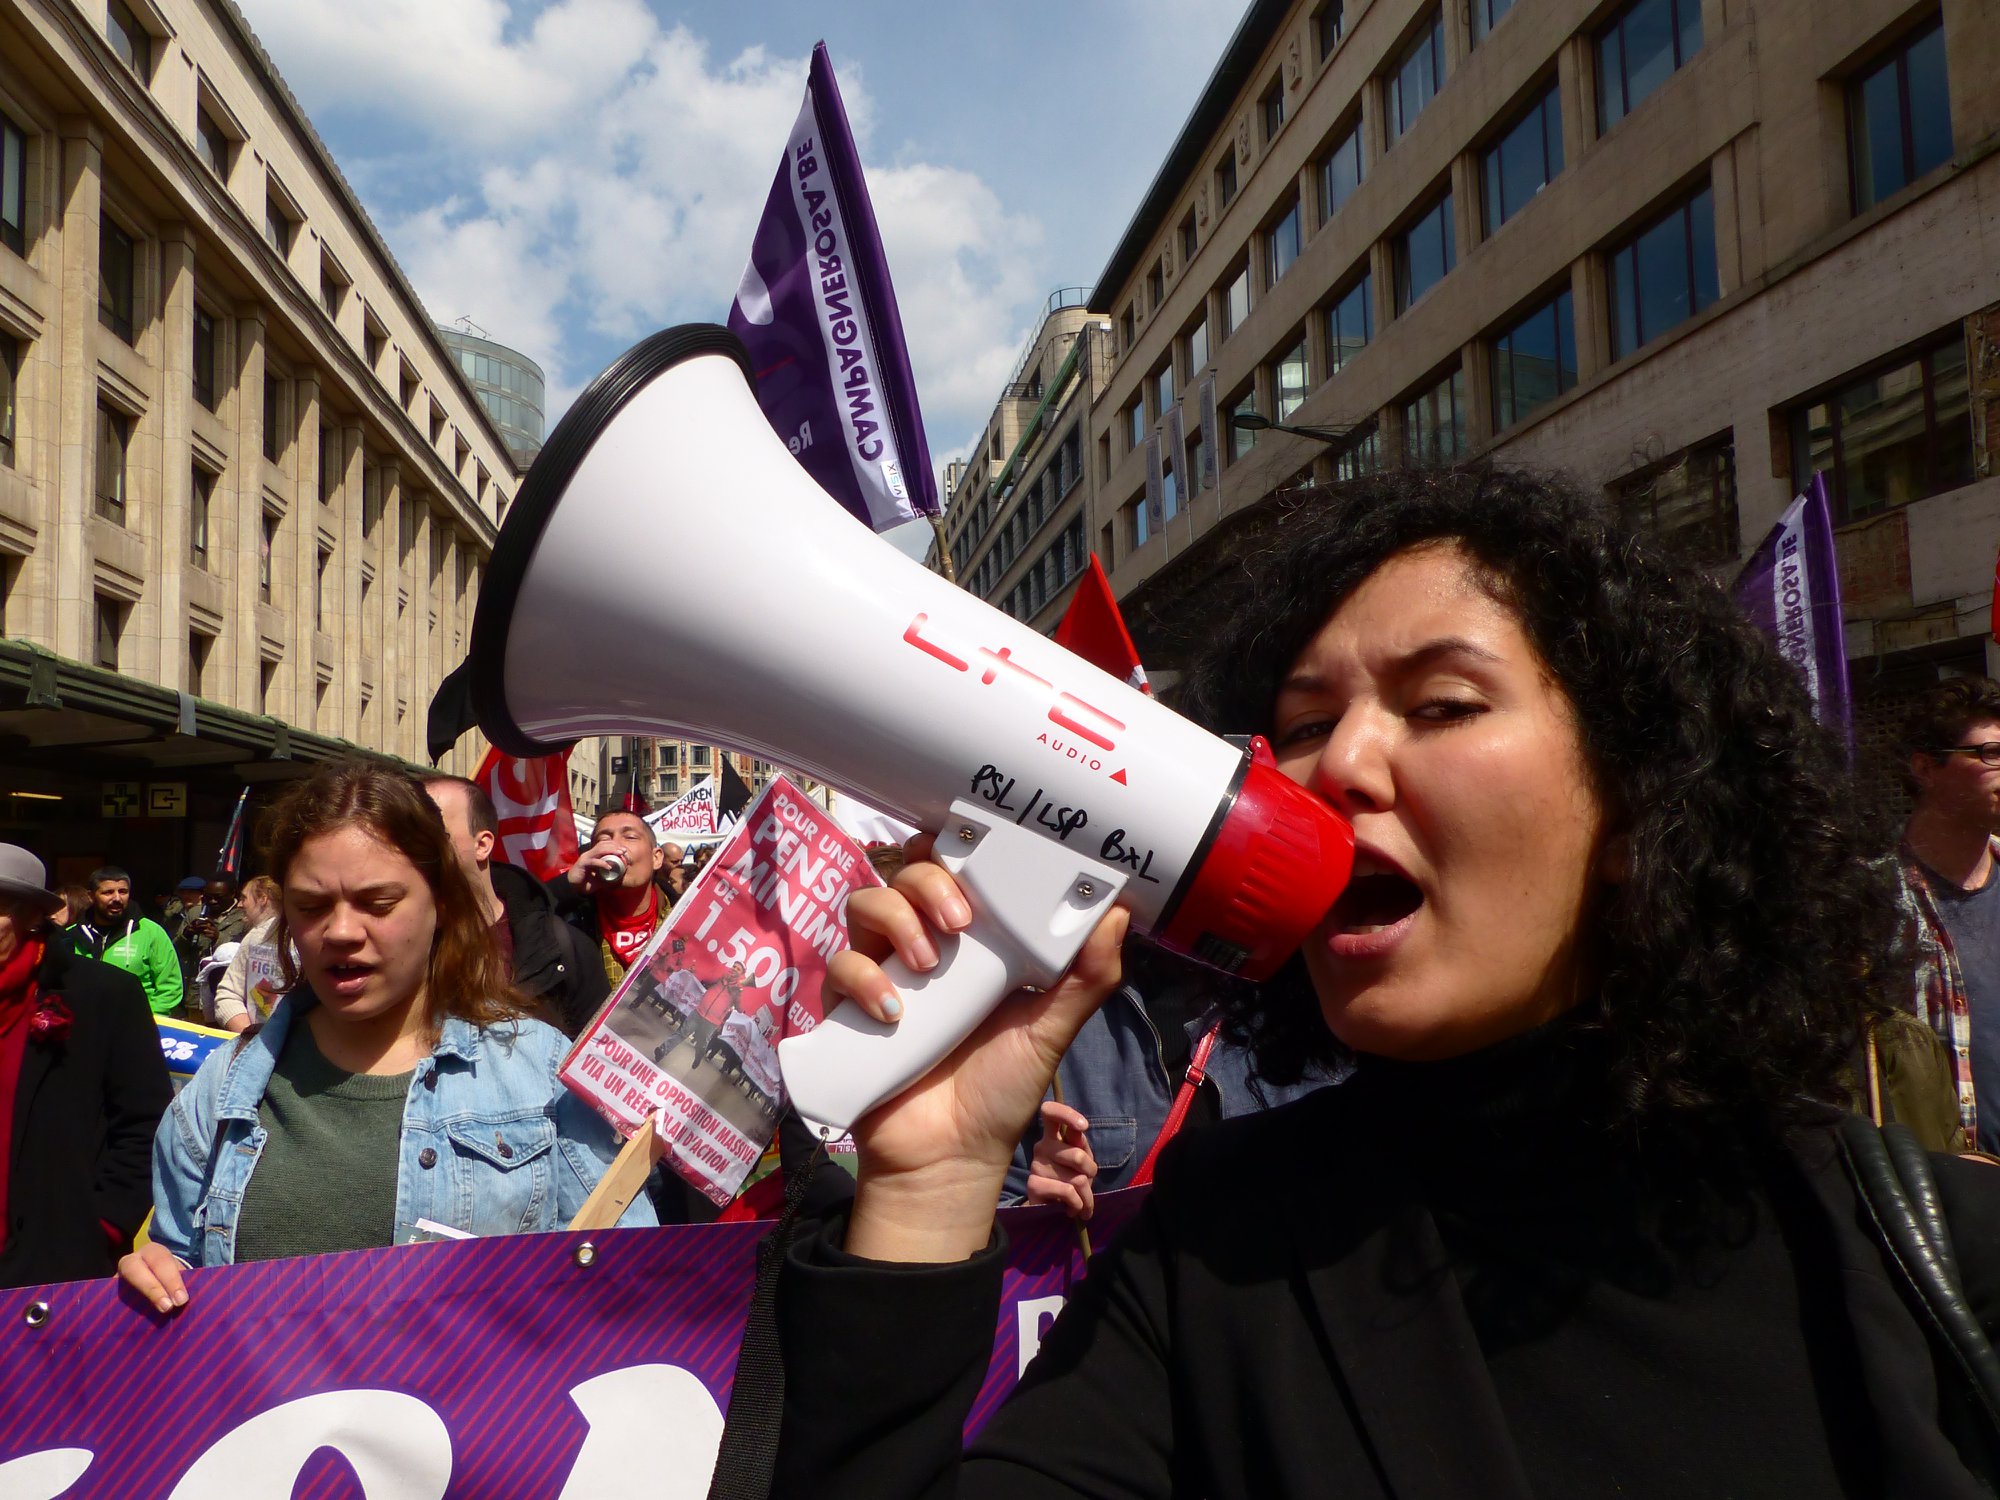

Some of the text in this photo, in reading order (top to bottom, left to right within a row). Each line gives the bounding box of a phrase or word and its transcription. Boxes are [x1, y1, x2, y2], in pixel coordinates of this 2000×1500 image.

[1036, 732, 1102, 772] AUDIO
[772, 793, 855, 873] POUR UNE
[713, 878, 740, 906] DE
[694, 900, 800, 1007] 1.500
[580, 1053, 606, 1083] VIA
[603, 1070, 627, 1097] UN
[681, 1131, 731, 1174] D'ACTION
[595, 1033, 635, 1071] POUR
[629, 1059, 659, 1088] UNE
[655, 1080, 718, 1136] OPPOSITION
[714, 1123, 757, 1166] MASSIVE
